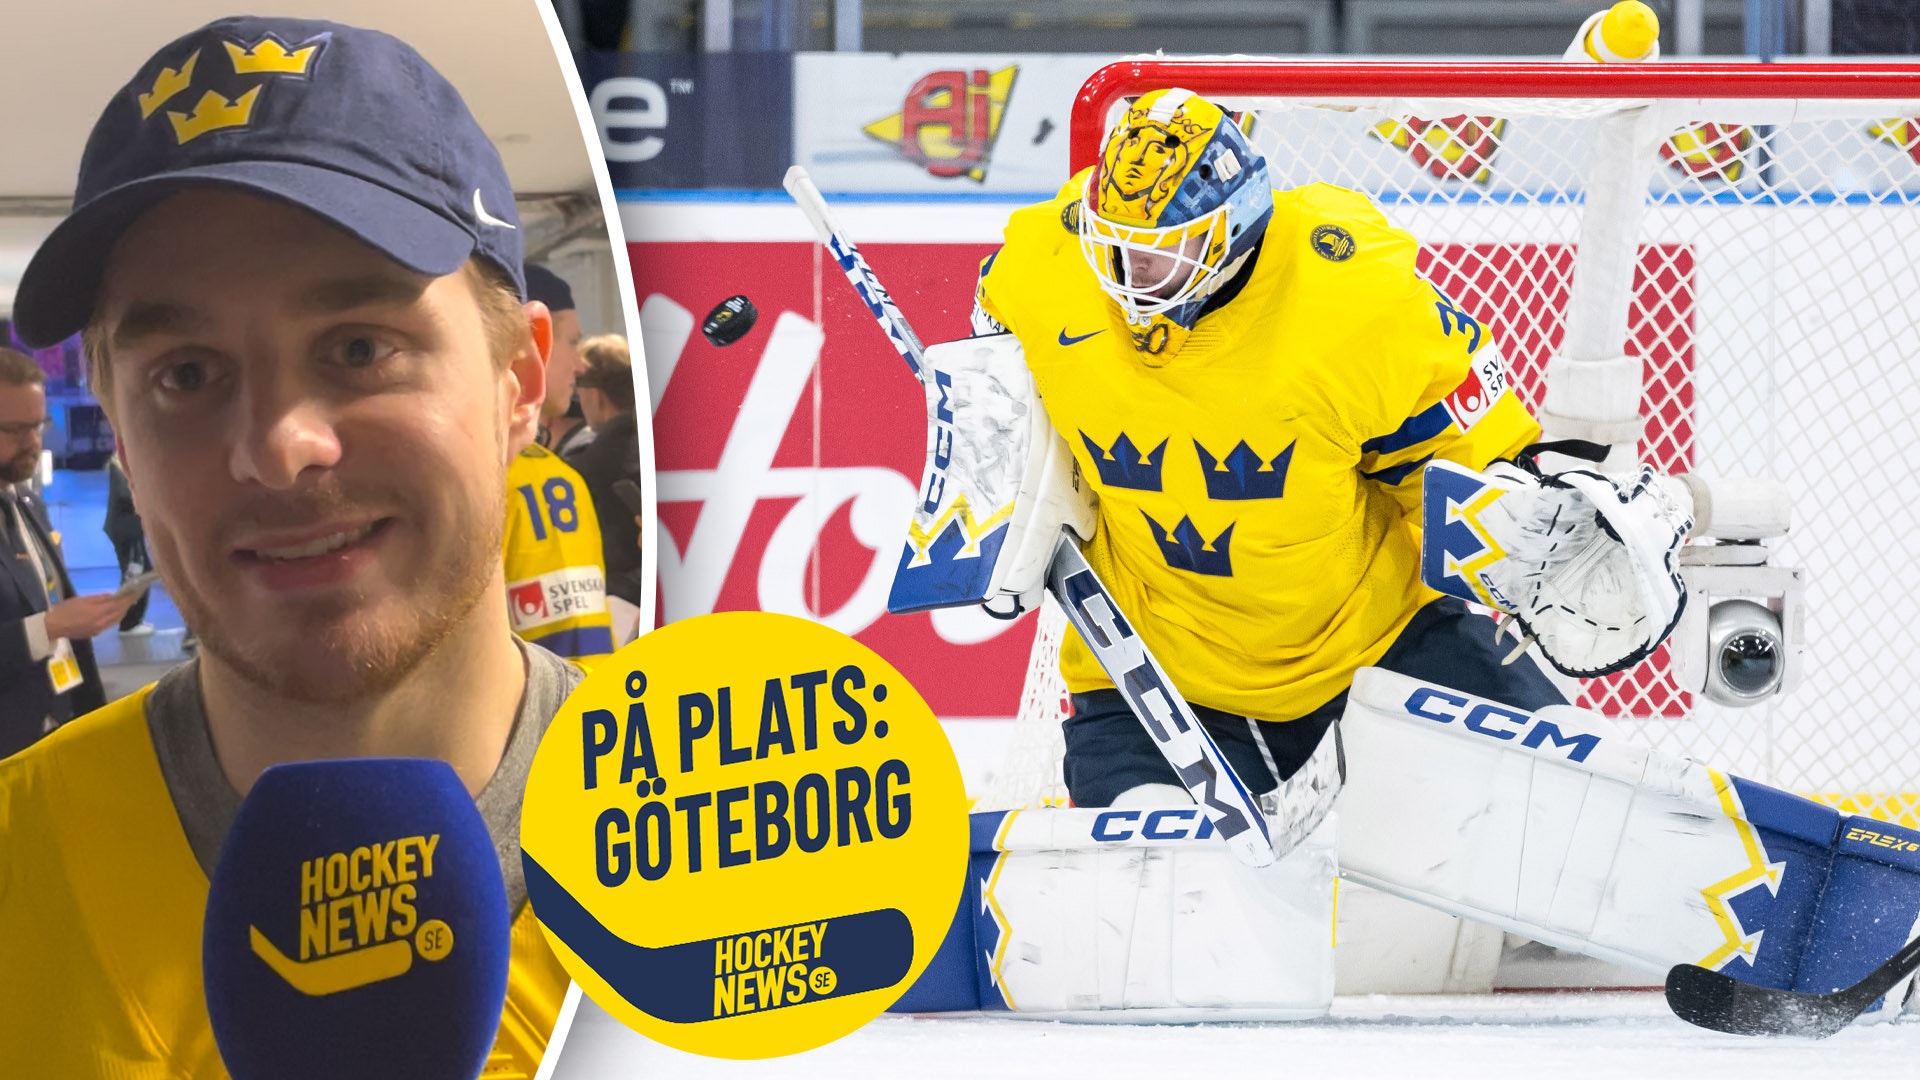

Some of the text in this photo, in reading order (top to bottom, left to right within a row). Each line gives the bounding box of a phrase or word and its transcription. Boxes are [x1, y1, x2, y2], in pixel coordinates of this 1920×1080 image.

[1431, 284, 1482, 354] 3
[924, 369, 954, 515] CCM
[517, 476, 579, 541] 18
[553, 596, 589, 615] SPEL
[1480, 573, 1518, 610] CCM
[1064, 568, 1251, 842] CCM
[1404, 687, 1602, 763] CCM
[301, 834, 440, 906] HOCKEY
[300, 883, 444, 961] NEWS SE
